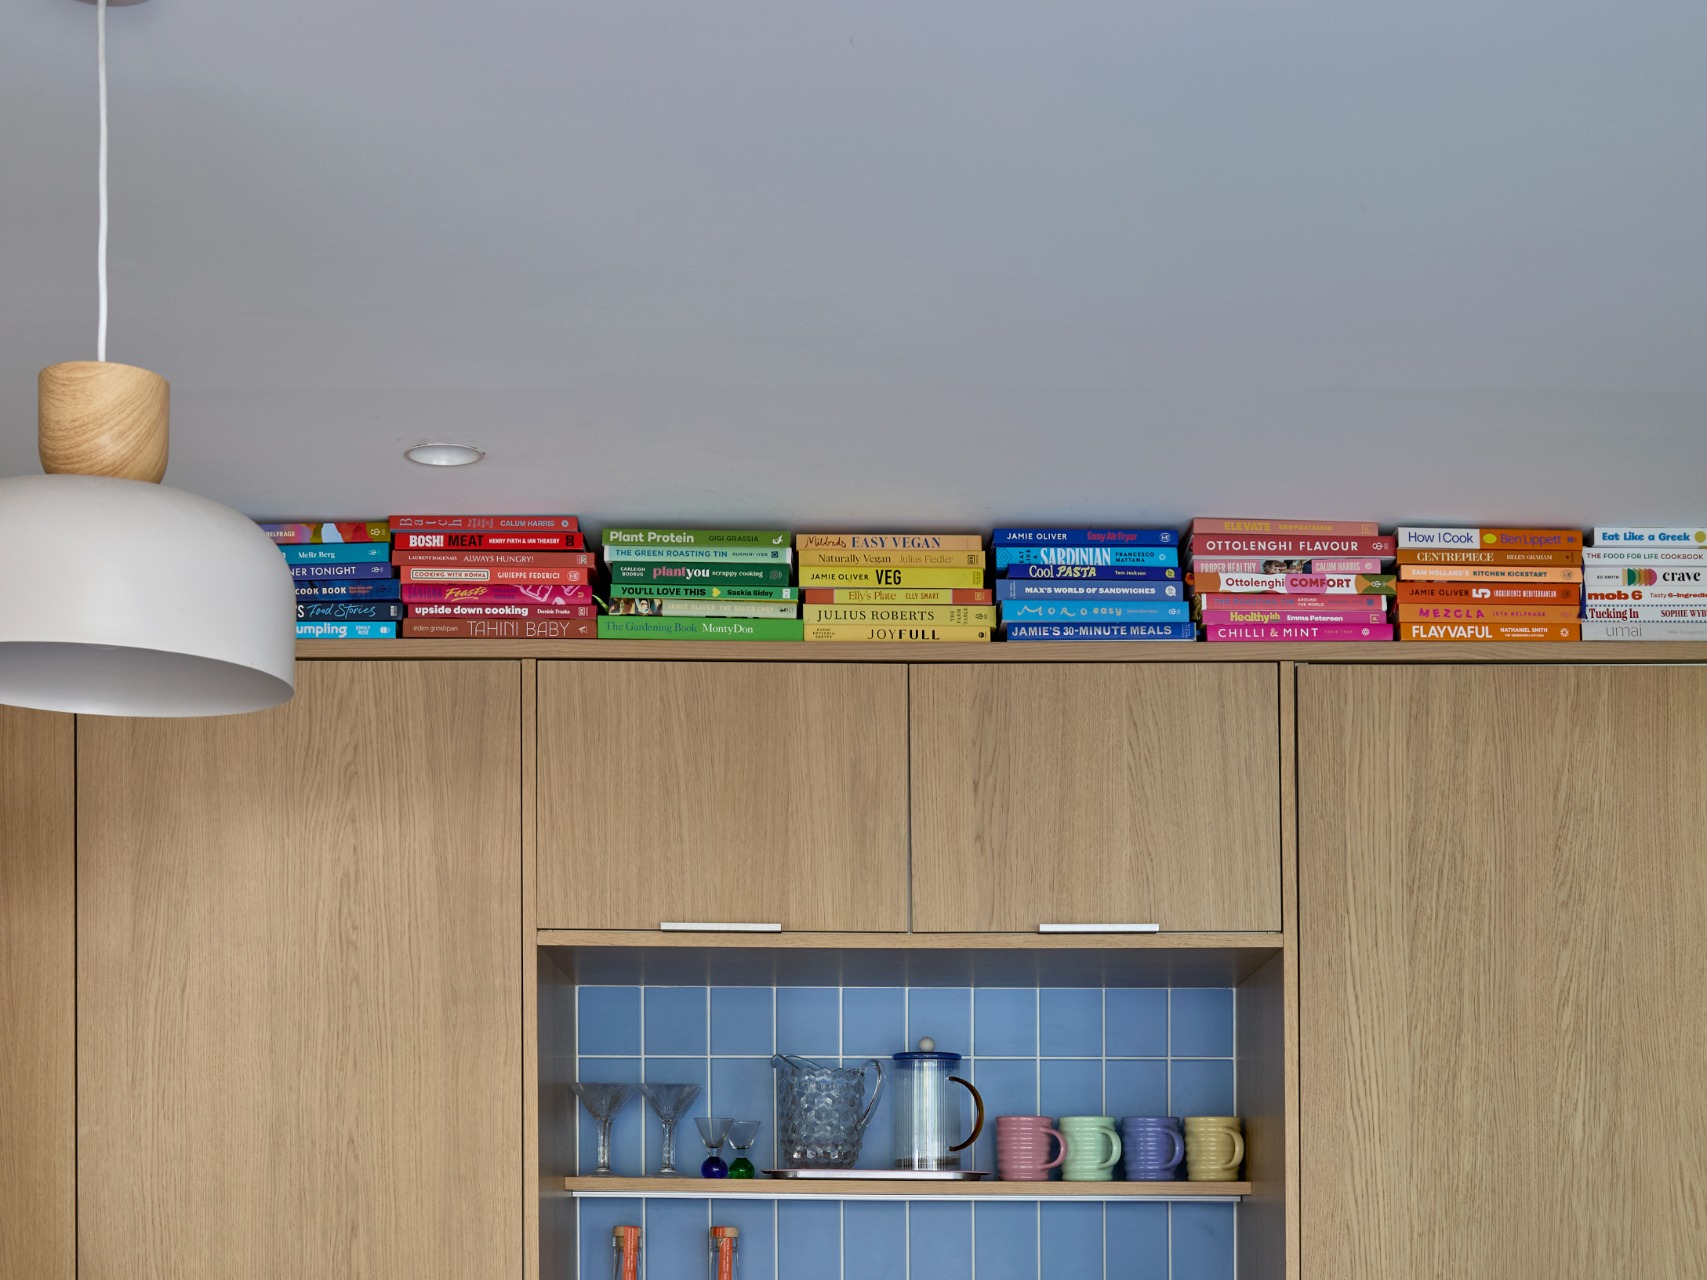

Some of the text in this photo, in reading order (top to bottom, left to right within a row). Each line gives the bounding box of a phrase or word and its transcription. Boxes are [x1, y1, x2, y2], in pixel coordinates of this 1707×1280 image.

[1224, 522, 1271, 531] ELEVATE
[409, 534, 484, 547] BOSH! MEAT
[610, 531, 694, 543] Plant Protein
[1006, 532, 1033, 540] JAMIE
[1088, 532, 1105, 542] Easy
[1408, 532, 1434, 543] How
[1444, 532, 1474, 544] Cook
[1501, 534, 1561, 546] Ben Lippett
[1602, 532, 1620, 540] Eat
[1624, 532, 1644, 541] Like
[1658, 532, 1690, 541] Greek
[852, 536, 887, 548] EASY
[892, 536, 941, 548] VEGAN
[1206, 540, 1358, 551] OTTOLENGHI FLAVOUR
[666, 550, 710, 558] ROASTING
[818, 554, 861, 565] Naturally
[864, 555, 891, 565] Vegan
[898, 554, 922, 564] Julius
[1040, 548, 1111, 566] SARDINIAN
[1417, 552, 1494, 562] CENTREPIECE
[310, 566, 356, 575] TONIGHT
[1029, 565, 1097, 578] Cool PASTA
[1200, 562, 1256, 573] PROPER HEALTHY
[1315, 562, 1360, 572] CALUM HARRIS
[876, 570, 902, 585] VEG
[1662, 572, 1701, 582] crave
[1225, 578, 1352, 590] Ottolenghi COMFORT
[444, 586, 488, 600] Feasts
[622, 587, 706, 596] YOU'LL LOVE THIS
[753, 590, 773, 598] Sidey
[848, 591, 897, 601] Elly's Plate
[905, 592, 939, 600] ELLY SMART
[1472, 588, 1491, 598] 5
[1588, 590, 1643, 600] mob 6
[307, 604, 333, 617] Food
[334, 604, 376, 619] Stories
[415, 605, 528, 616] upside down cooking
[817, 610, 935, 622] JULIUS ROBERTS
[1093, 607, 1122, 616] easy
[1419, 608, 1485, 618] MEZCLA
[1589, 608, 1639, 621] Tucking In
[295, 622, 347, 638] umpling
[466, 620, 570, 636] TAHINI BABY
[604, 622, 697, 634] The Gardening Book
[1012, 626, 1061, 636] JAMIE'S
[1063, 626, 1127, 636] 30-MINUTE
[1130, 626, 1172, 635] MEALS
[1218, 628, 1319, 638] CHILLI & MINT
[1412, 626, 1492, 638] FLAYVAFUL
[1606, 625, 1642, 637] umai
[867, 628, 940, 640] JOYFULL
